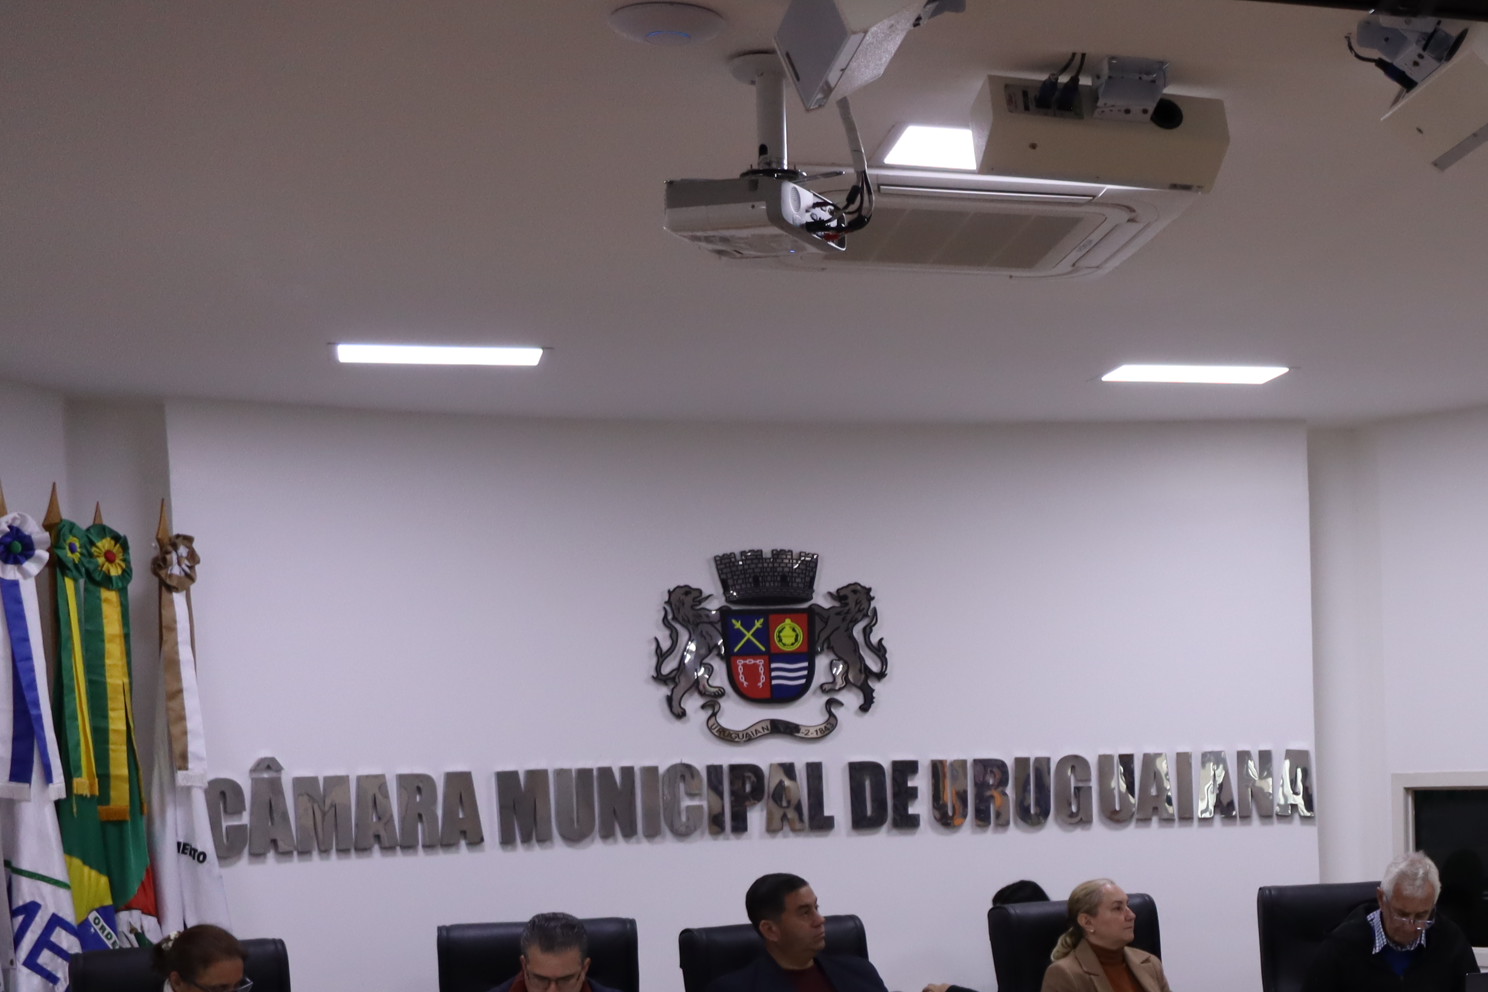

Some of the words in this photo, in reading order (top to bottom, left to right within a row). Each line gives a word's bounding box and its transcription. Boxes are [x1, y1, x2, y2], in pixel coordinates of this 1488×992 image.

[710, 721, 772, 742] URUGUAIAN
[204, 756, 486, 861] CÂMARA
[495, 760, 835, 848] MUNICIPAL
[848, 759, 922, 831] DE
[930, 749, 1316, 828] URUGUAIANA
[93, 915, 119, 949] ORDE
